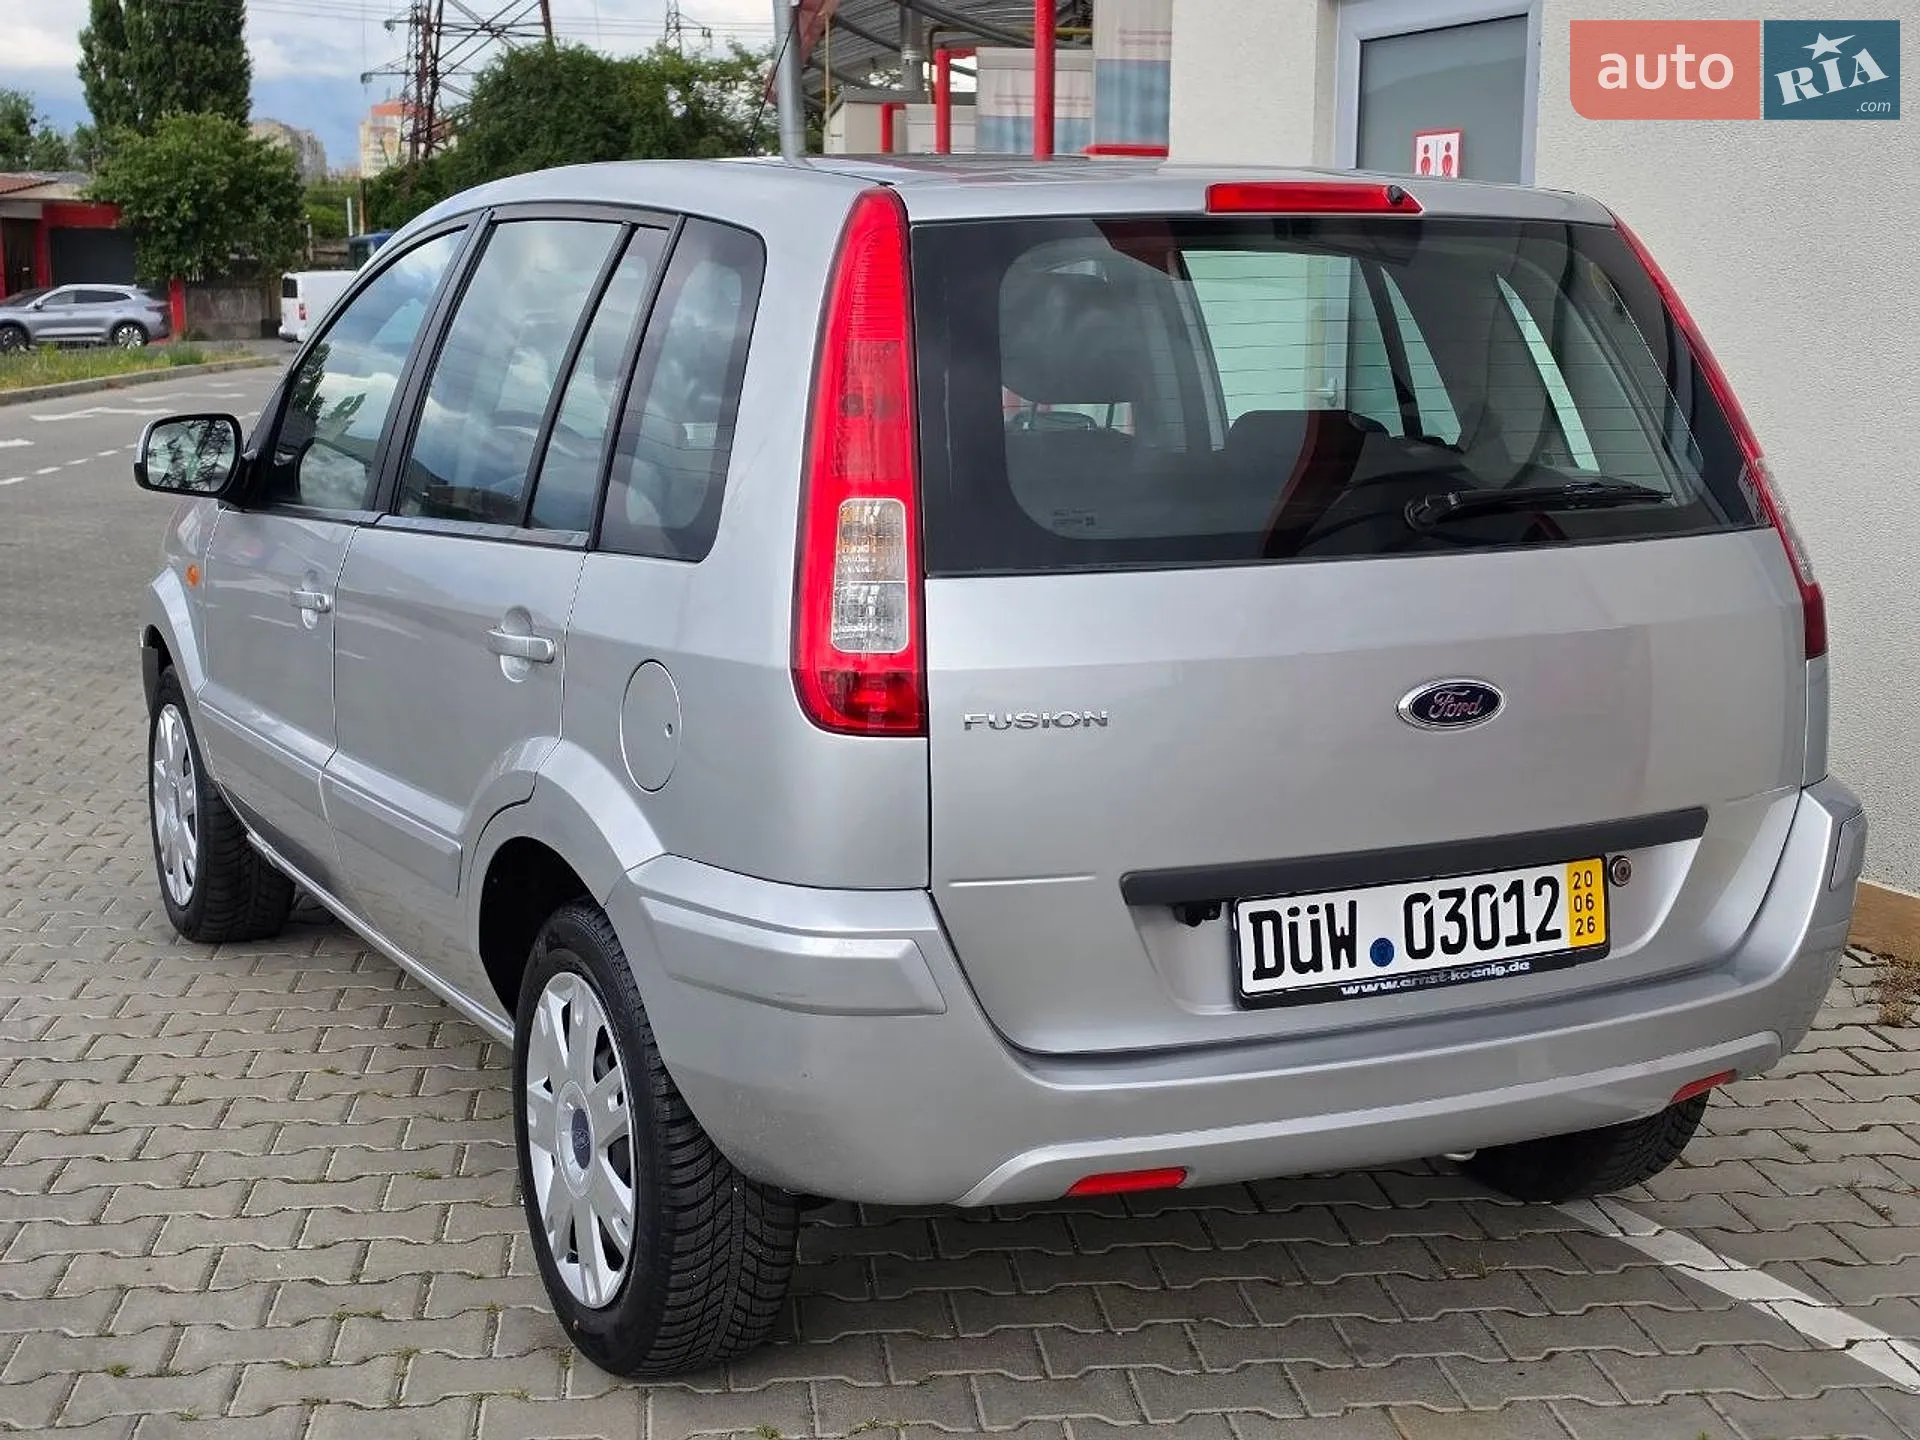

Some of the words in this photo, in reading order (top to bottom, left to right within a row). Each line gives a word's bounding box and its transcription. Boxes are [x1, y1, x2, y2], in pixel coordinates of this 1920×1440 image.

[1428, 689, 1484, 718] Ford
[964, 711, 1108, 730] FUSION
[1573, 870, 1592, 890] 20
[1574, 892, 1594, 912] 06
[1404, 876, 1562, 960] 03012
[1576, 915, 1595, 936] 26
